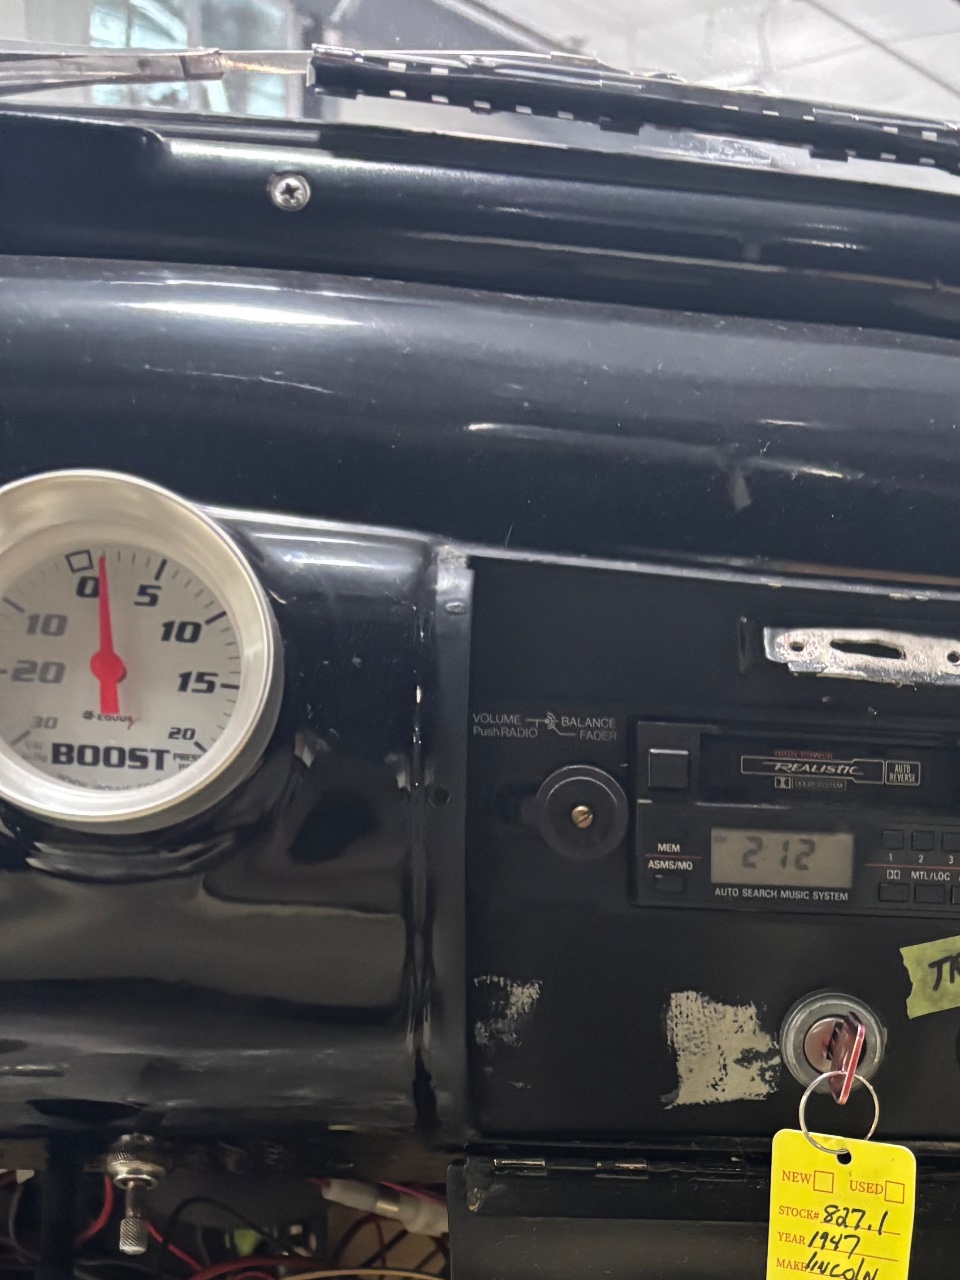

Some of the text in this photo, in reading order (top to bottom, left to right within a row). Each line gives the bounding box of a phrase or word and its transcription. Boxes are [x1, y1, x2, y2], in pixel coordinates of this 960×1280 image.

[76, 577, 99, 598] 0
[134, 585, 162, 607] 5
[27, 614, 68, 637] 10
[161, 621, 202, 643] 10
[11, 660, 66, 684] 20
[177, 671, 219, 694] 15
[32, 716, 59, 730] 30
[473, 713, 521, 724] VOLUME
[561, 716, 617, 729] BALANCE
[167, 727, 196, 741] 20
[473, 726, 538, 738] Push RADIO
[580, 730, 617, 741] FADER
[52, 743, 171, 771] BOOST
[894, 763, 911, 773] AUTO
[889, 773, 916, 783] REVERSE
[657, 843, 680, 853] MEM
[648, 859, 693, 870] ASMS/MO
[889, 853, 893, 861] 1
[918, 854, 924, 863] 2
[949, 855, 954, 864] 3
[911, 871, 950, 881] MTL/LOC
[714, 887, 849, 901] AUTO SEARCH MUSIC SYSTEM
[782, 1170, 884, 1196] NEW USED
[778, 1205, 820, 1220] STOCK#
[778, 1231, 861, 1259] YEAR 1947
[776, 1257, 807, 1272] MAKE
